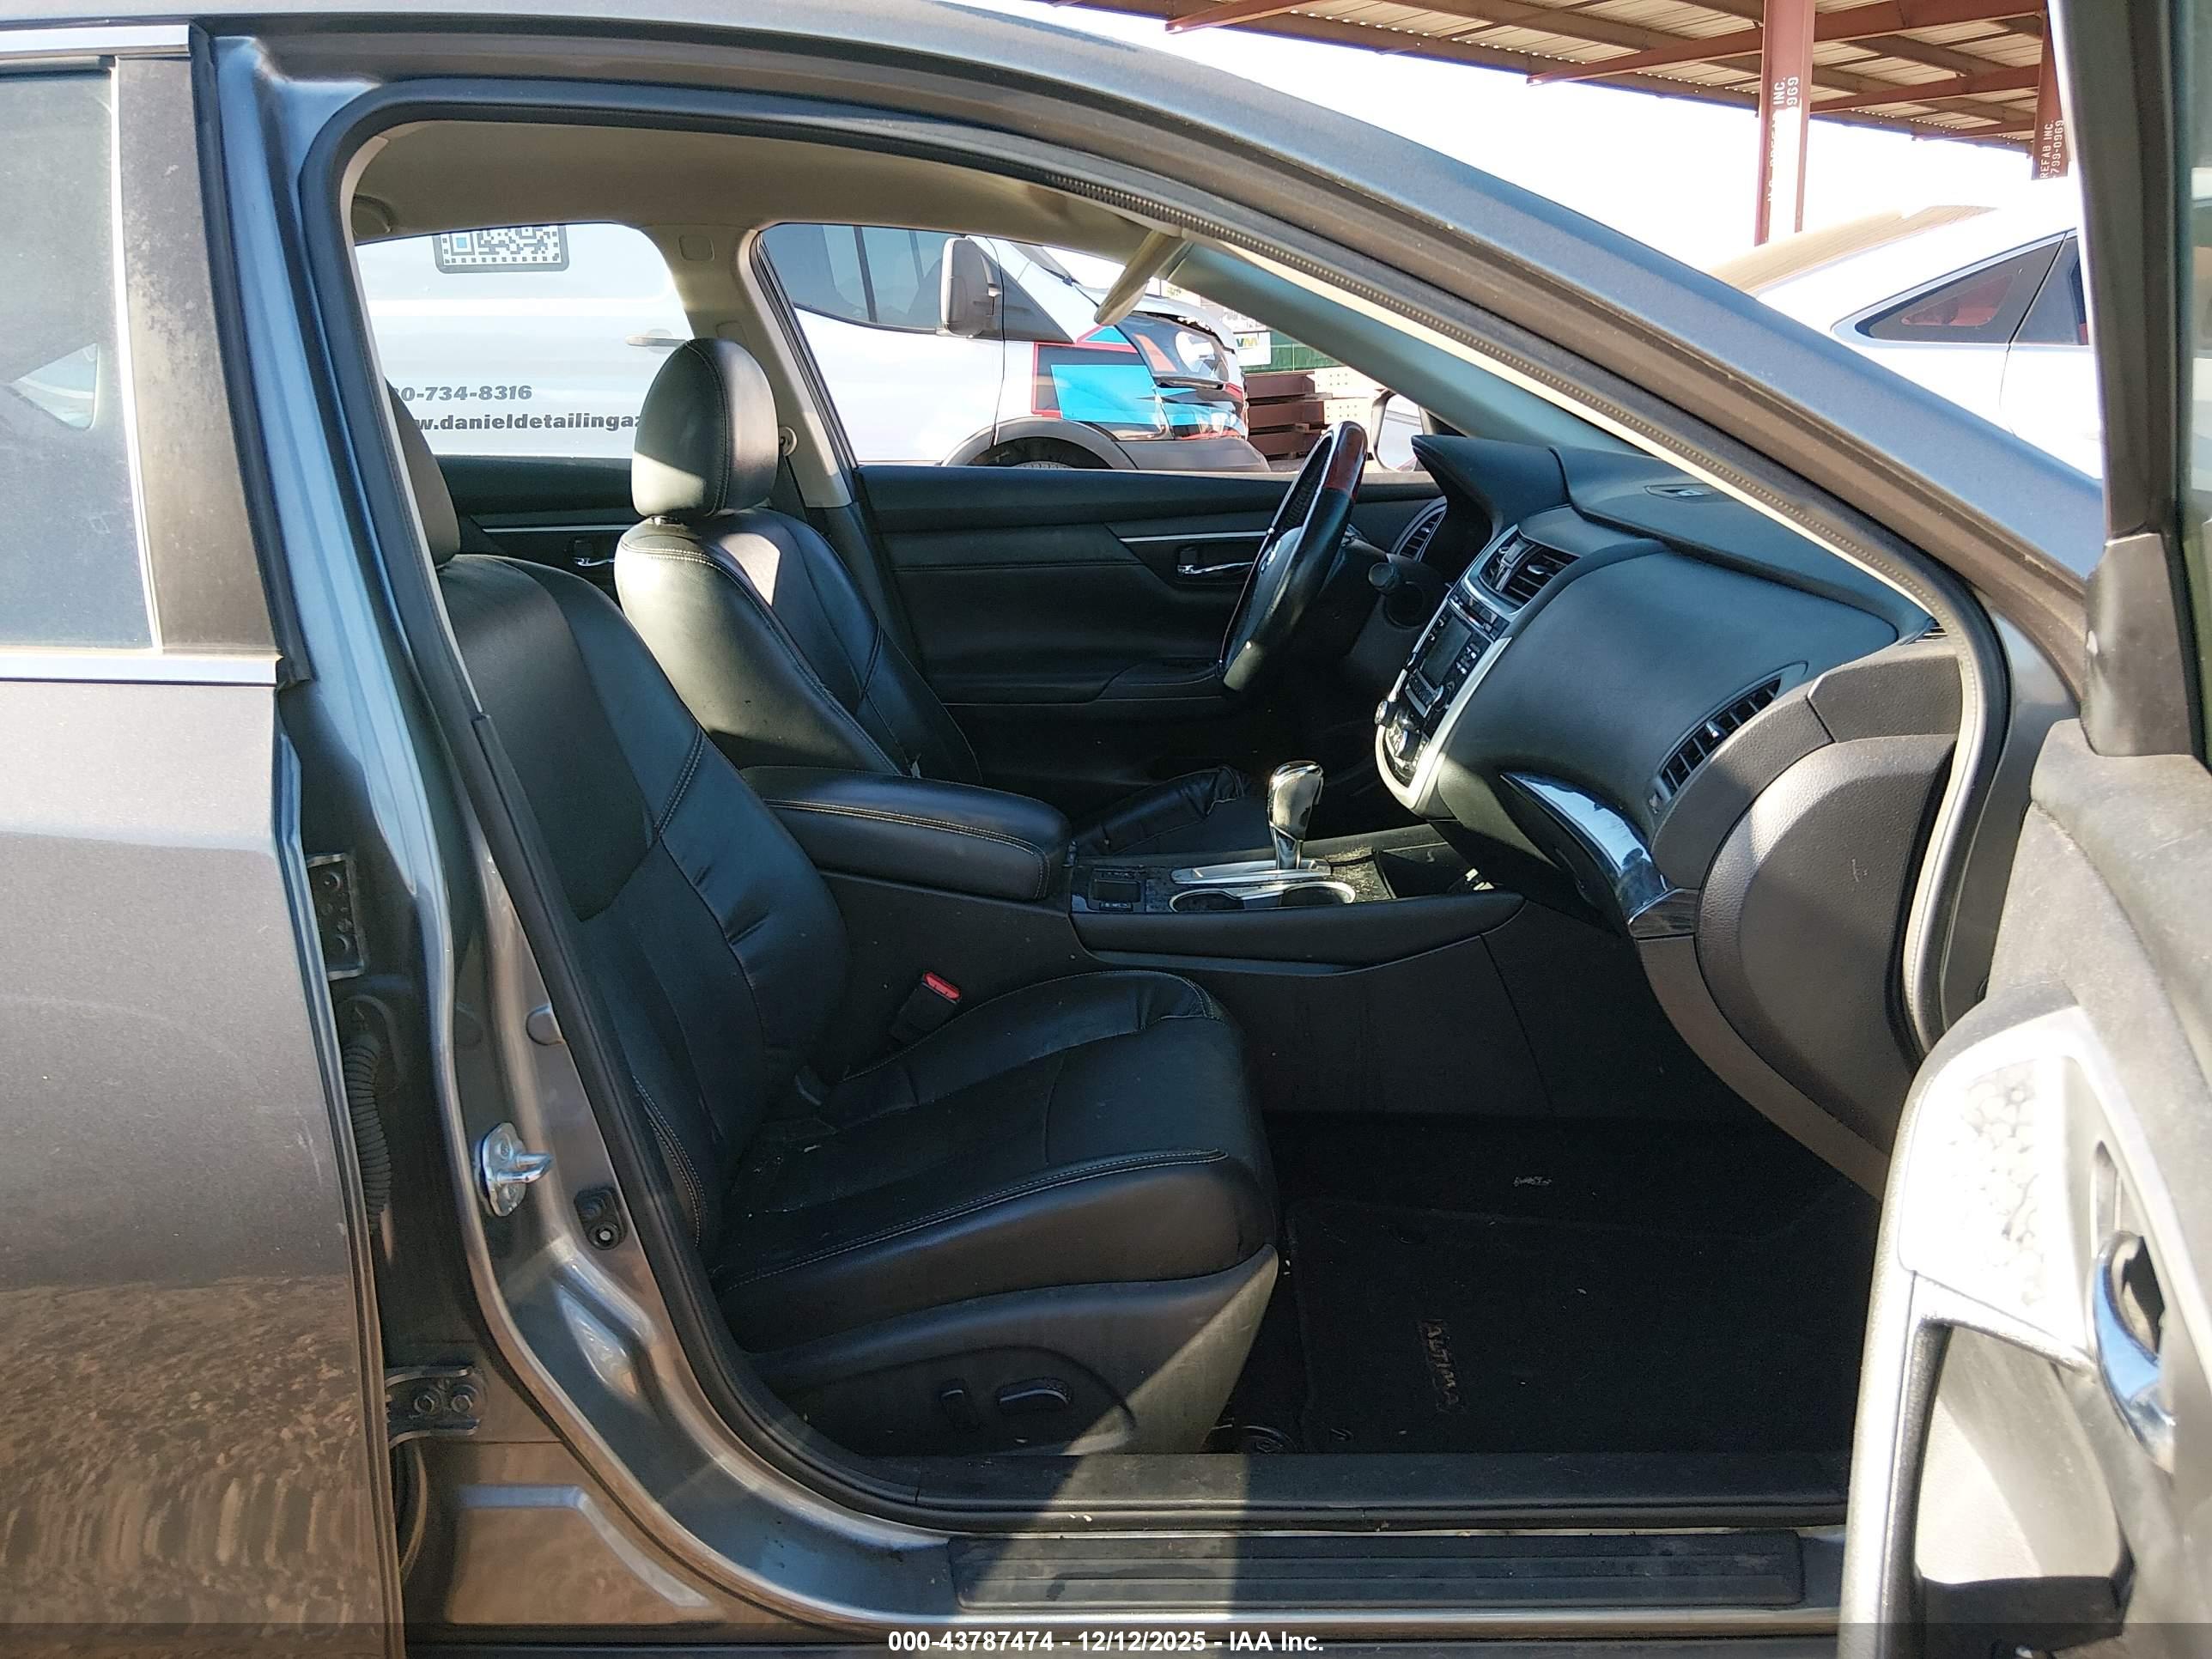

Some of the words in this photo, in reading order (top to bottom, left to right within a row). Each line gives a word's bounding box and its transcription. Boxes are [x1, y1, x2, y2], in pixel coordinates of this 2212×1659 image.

[1773, 77, 1785, 105] INC.
[2044, 120, 2053, 141] INC.
[395, 386, 532, 402] 0-734-8316
